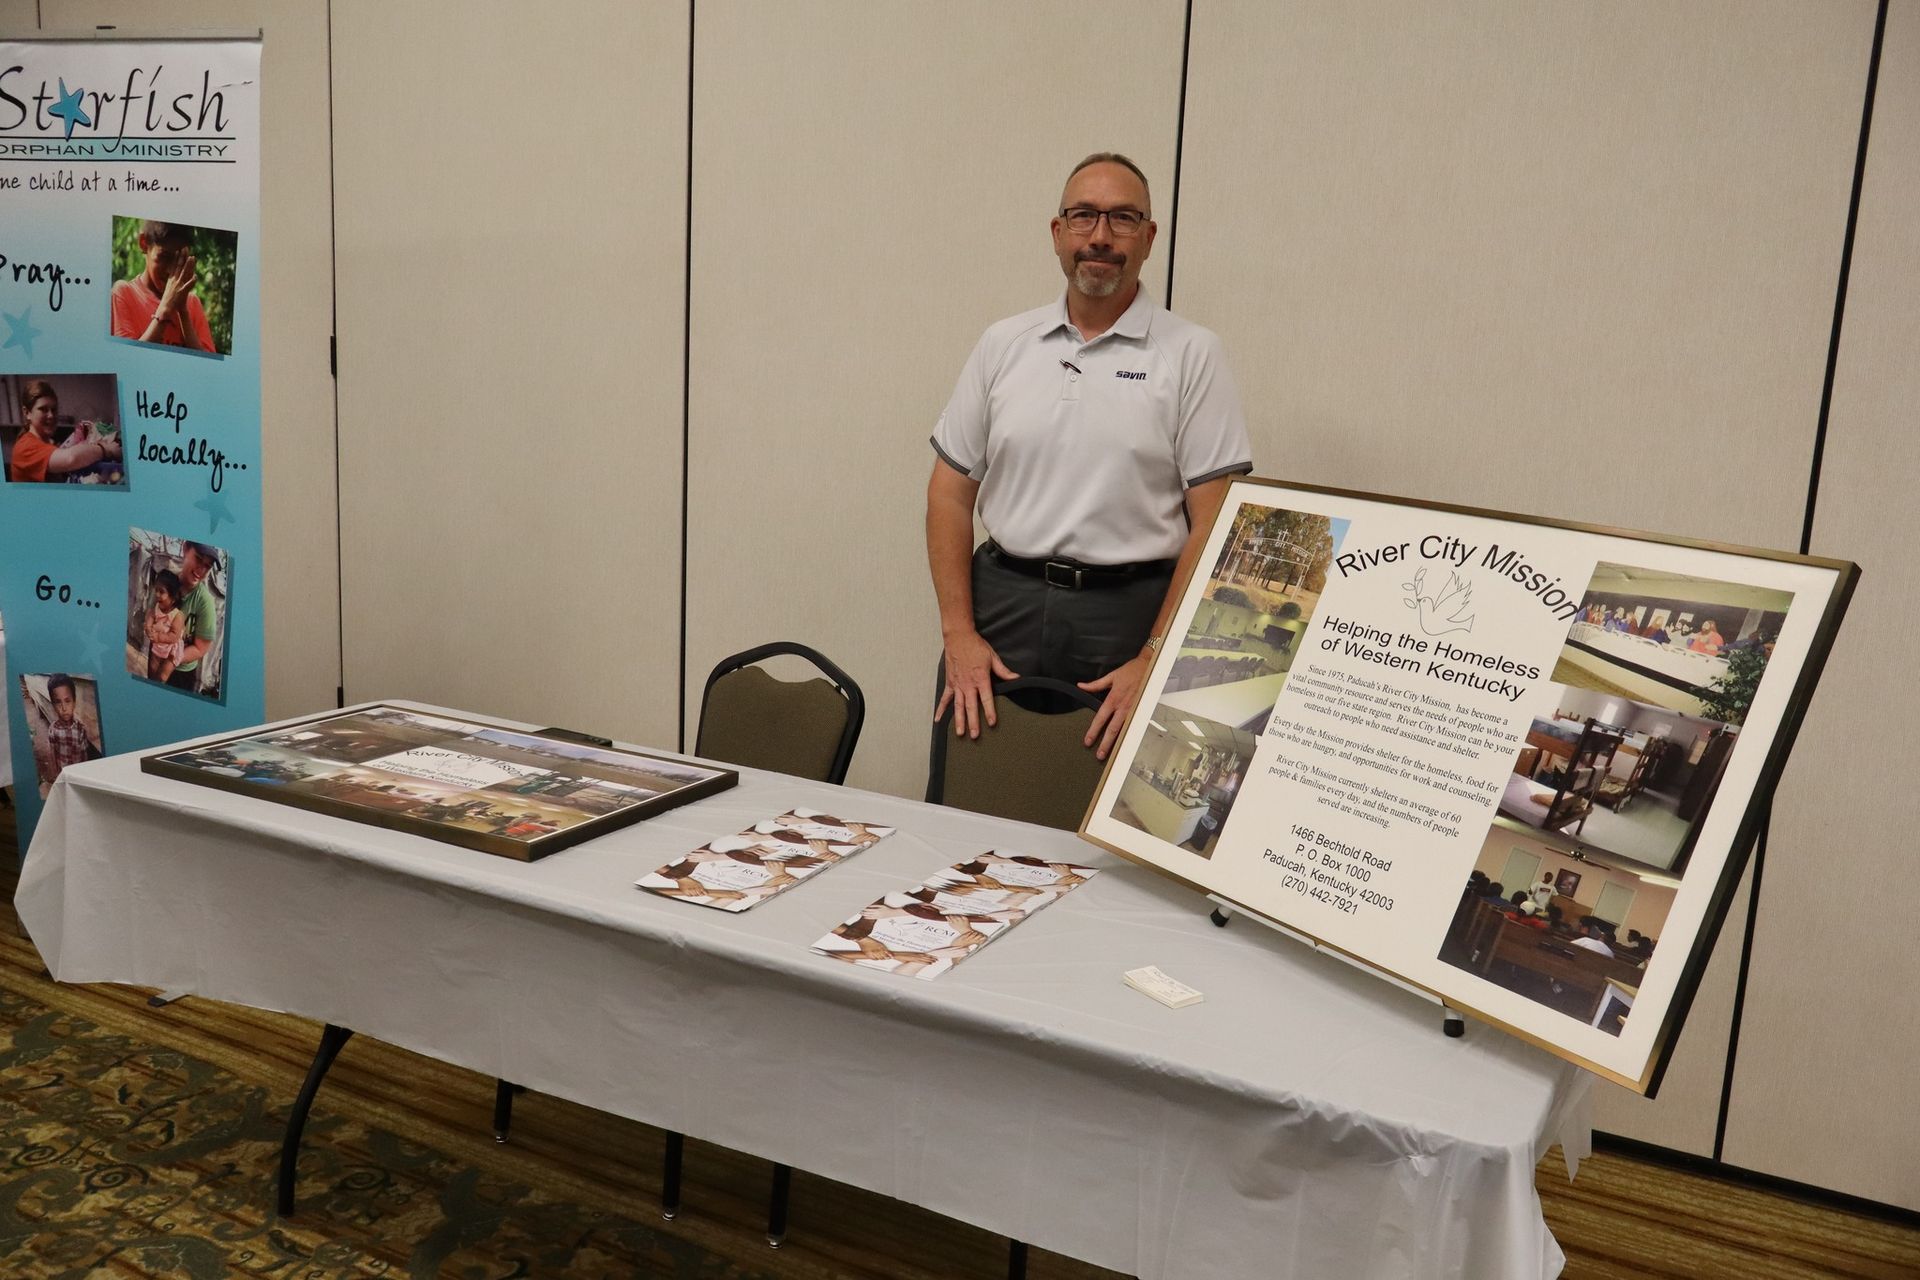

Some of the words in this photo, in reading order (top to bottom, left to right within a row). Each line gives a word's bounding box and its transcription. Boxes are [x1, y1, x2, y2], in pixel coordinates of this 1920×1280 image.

[121, 144, 228, 157] MINISTRY
[0, 176, 21, 190] ne
[29, 170, 74, 190] child
[81, 171, 100, 189] at
[108, 181, 117, 190] a
[126, 172, 180, 191] time...
[1116, 370, 1147, 380] savin
[136, 390, 188, 433] Help
[138, 434, 247, 493] locally...
[35, 574, 100, 608] Go...
[1336, 541, 1410, 578] River
[1419, 535, 1478, 567] City
[1481, 544, 1581, 622] Mission
[1320, 637, 1341, 652] of
[1344, 640, 1420, 673] Western
[1425, 660, 1526, 702] Kentucky
[1322, 615, 1392, 647] Helping
[1397, 633, 1428, 652] the
[1433, 640, 1540, 679] Homeless
[1286, 682, 1315, 697] homeless
[1324, 695, 1336, 703] our
[1337, 696, 1351, 707] five
[1351, 703, 1368, 712] state
[1368, 708, 1391, 720] region.
[1396, 713, 1417, 726] River
[1418, 720, 1435, 733] City
[1435, 725, 1466, 741] Mission
[1467, 736, 1482, 746] can
[1483, 738, 1494, 749] be
[1493, 744, 1514, 755] your
[1292, 674, 1307, 682] vital
[1307, 678, 1344, 695] community
[1344, 688, 1374, 701] resource
[1373, 696, 1388, 705] and
[1388, 700, 1411, 712] serves
[1412, 705, 1424, 716] the
[1425, 711, 1447, 722] needs
[1448, 716, 1459, 725] of
[1456, 720, 1484, 732] people
[1486, 727, 1503, 738] who
[1504, 733, 1518, 742] are
[1307, 664, 1326, 676] Since
[1327, 669, 1344, 681] 1975,
[1346, 674, 1381, 691] Paducah's
[1381, 683, 1402, 696] River
[1402, 689, 1419, 702] City
[1419, 693, 1451, 711] Mission,
[1455, 703, 1469, 715] has
[1470, 707, 1501, 723] become
[406, 750, 454, 758] River
[1273, 715, 1292, 729] Every
[1292, 721, 1305, 733] day
[1305, 726, 1316, 735] the
[1317, 729, 1344, 744] Mission
[1343, 739, 1375, 754] provides
[1375, 748, 1400, 762] shelter
[1400, 755, 1413, 765] for
[1413, 759, 1425, 770] the
[1426, 762, 1463, 783] homeless,
[1465, 775, 1485, 789] food
[1485, 782, 1498, 792] for
[1303, 702, 1331, 715] outreach
[1332, 709, 1340, 717] to
[1339, 712, 1363, 724] people
[1365, 719, 1380, 729] who
[1380, 724, 1399, 735] need
[1398, 730, 1436, 746] assistance
[1436, 741, 1452, 750] and
[1451, 744, 1479, 759] shelter.
[1268, 726, 1285, 738] those
[1286, 733, 1300, 743] who
[1300, 738, 1312, 747] are
[1312, 740, 1336, 756] hungry,
[1338, 751, 1352, 760] and
[1352, 755, 1398, 775] opportunities
[1399, 768, 1411, 779] for
[1412, 774, 1431, 786] work
[1432, 781, 1448, 791] and
[1448, 786, 1491, 807] counseling.
[1276, 753, 1295, 766] River
[1295, 760, 1310, 773] City
[1310, 765, 1337, 781] Mission
[1337, 777, 1369, 794] currently
[1369, 786, 1398, 802] shelters
[1398, 797, 1408, 806] an
[1409, 801, 1439, 817] average
[1439, 811, 1451, 819] of
[1450, 813, 1461, 823] 60
[1267, 766, 1290, 778] people
[1290, 772, 1298, 781] &
[1299, 774, 1326, 791] families
[1326, 786, 1346, 799] every
[1346, 791, 1360, 804] day,
[1361, 798, 1377, 808] and
[1376, 802, 1389, 812] the
[1389, 808, 1421, 824] numbers
[1422, 819, 1434, 828] of
[1431, 823, 1459, 837] people
[1316, 796, 1340, 809] served
[1339, 804, 1352, 813] are
[1352, 806, 1390, 829] increasing.
[1290, 823, 1315, 841] 1466
[1314, 832, 1361, 859] Bechtold
[1361, 850, 1392, 871] Road
[1294, 843, 1305, 856] P.
[1307, 848, 1317, 862] O.
[1320, 853, 1342, 871] Box
[1345, 863, 1371, 882] 1000
[1262, 848, 1306, 877] Paducah,
[1309, 867, 1358, 898] Kentucky
[1358, 888, 1393, 911] 42003
[1280, 873, 1308, 896] (270)
[1309, 886, 1358, 915] 442-7921
[924, 925, 956, 938] RCM
